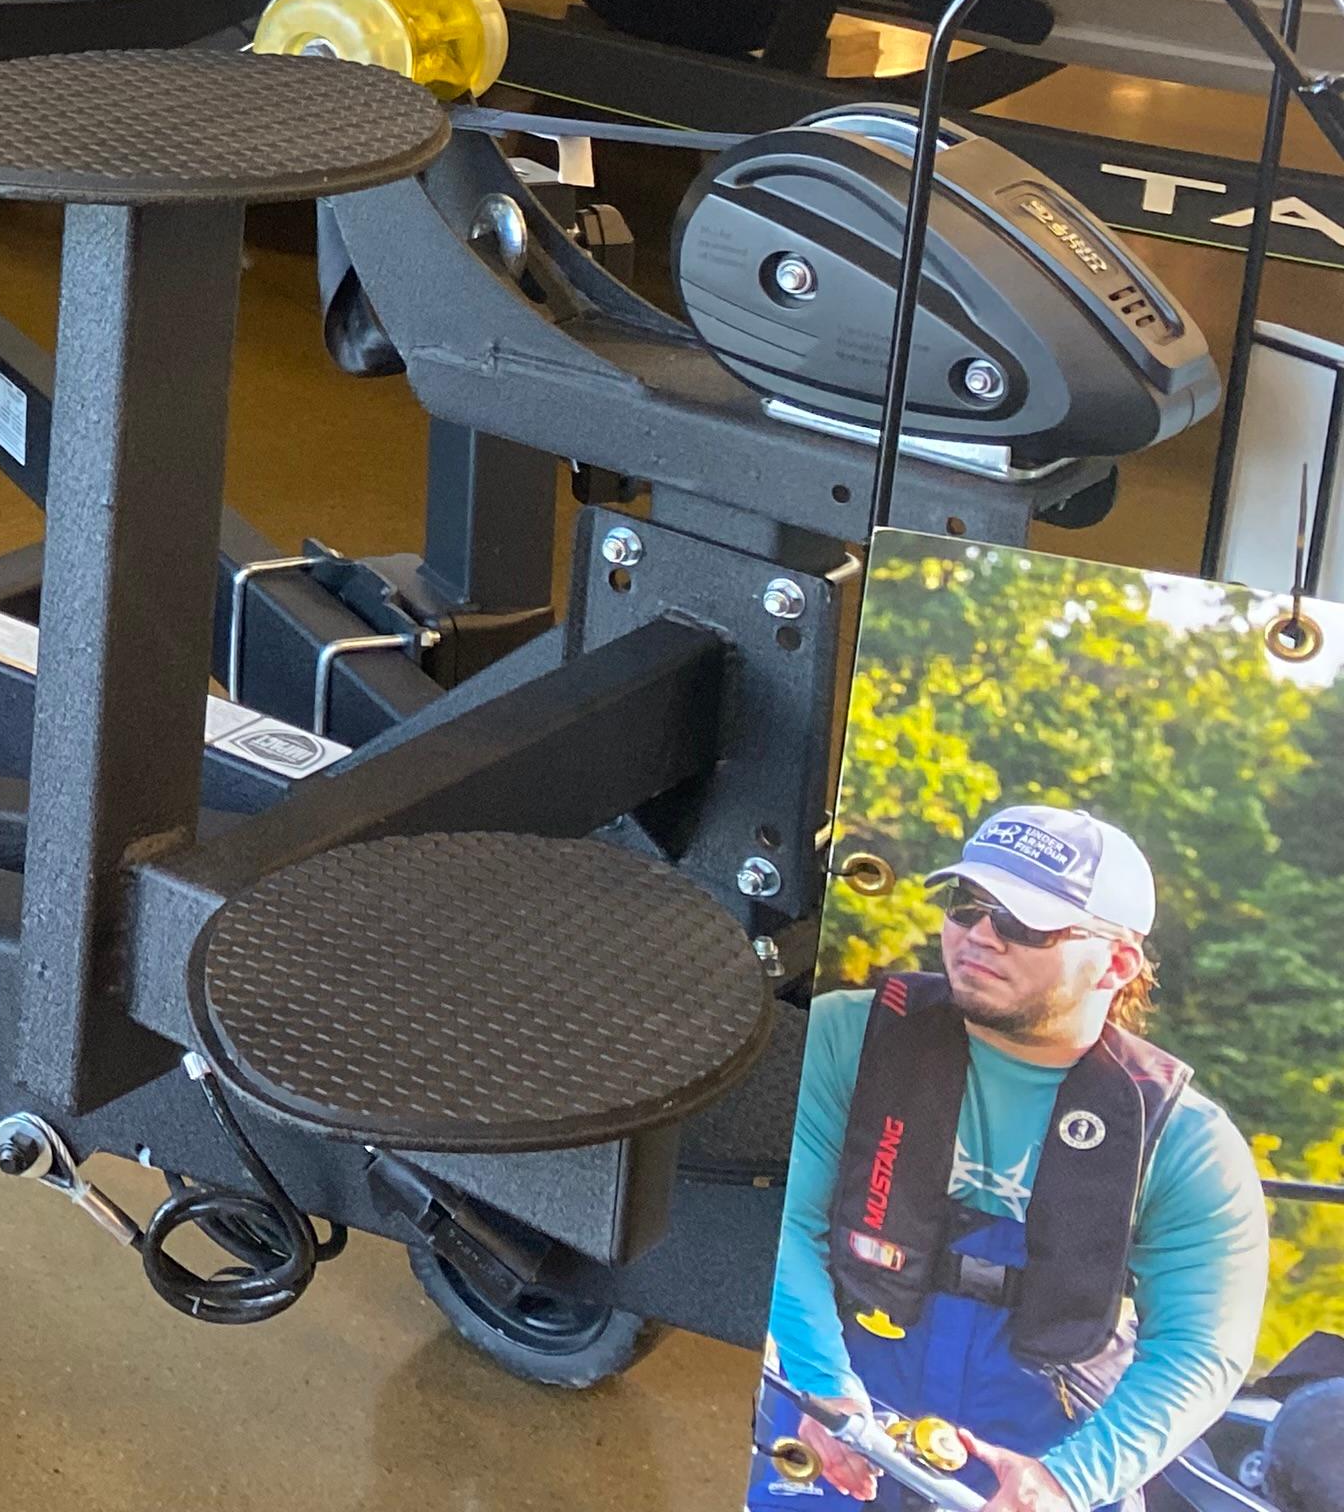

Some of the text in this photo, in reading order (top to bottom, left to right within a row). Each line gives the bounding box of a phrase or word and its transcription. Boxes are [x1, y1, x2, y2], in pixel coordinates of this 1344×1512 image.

[1018, 834, 1069, 865] ARMOUR
[1025, 827, 1065, 852] UNDER
[863, 1116, 905, 1231] MUSTANG
